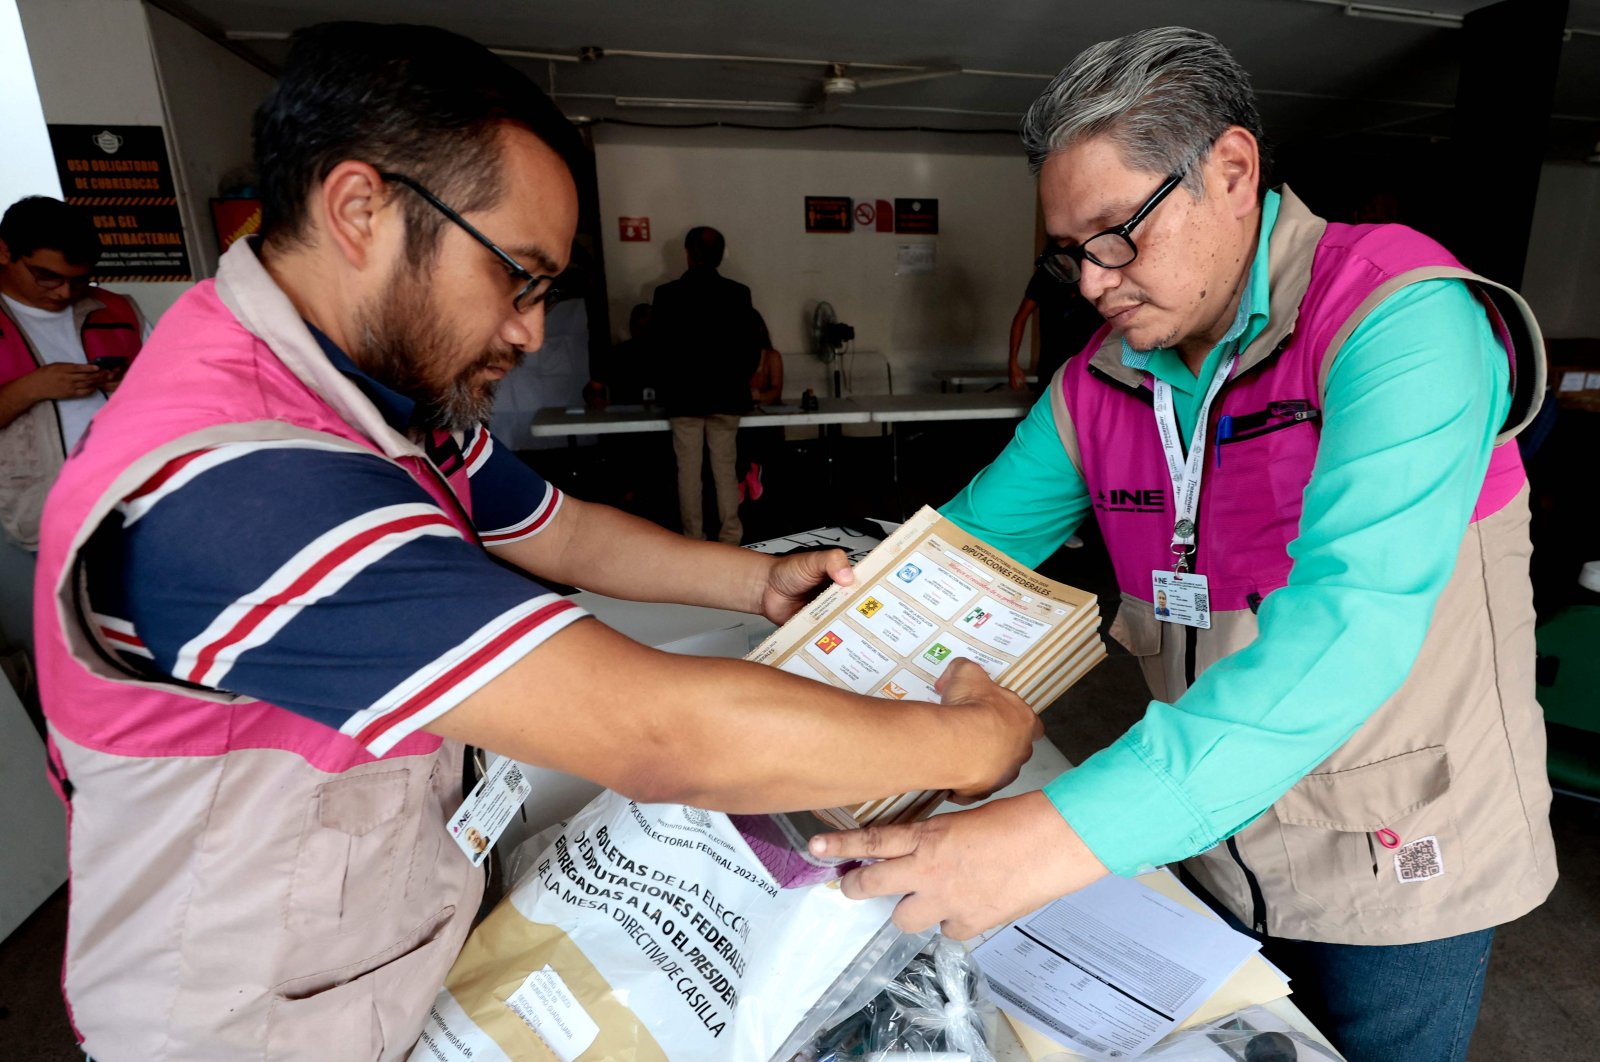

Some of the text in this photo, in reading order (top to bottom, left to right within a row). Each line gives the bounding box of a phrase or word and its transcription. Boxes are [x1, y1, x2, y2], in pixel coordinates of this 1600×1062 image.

[67, 160, 159, 172] USO OBLIGATORIO
[75, 178, 160, 189] DE CUBREBOCAS
[93, 215, 138, 228] USA GEL
[1110, 489, 1164, 506] INE
[961, 544, 1012, 580] DIPUTACIONES
[1010, 574, 1052, 596] FEDERALES
[457, 809, 472, 828] INE
[657, 818, 736, 853] INSTITUTO NACIONAL ELECTORAL
[596, 824, 649, 877] BOLETAS
[651, 870, 677, 885] DE
[679, 880, 700, 896] LA
[642, 823, 694, 849] ELECTORAL
[696, 842, 733, 871] FEDERAL
[733, 865, 779, 899] 2023-2024
[555, 834, 624, 901] ENTREGADAS
[626, 896, 638, 908] A
[642, 902, 663, 926] LA
[662, 919, 675, 936] O
[671, 930, 690, 953] EL
[582, 843, 694, 918] DIPUTACIONES
[690, 911, 746, 979] FEDERALES
[538, 858, 727, 1039] DE LA MESA DIRECTIVA DE CASILLA
[462, 1047, 473, 1059] de
